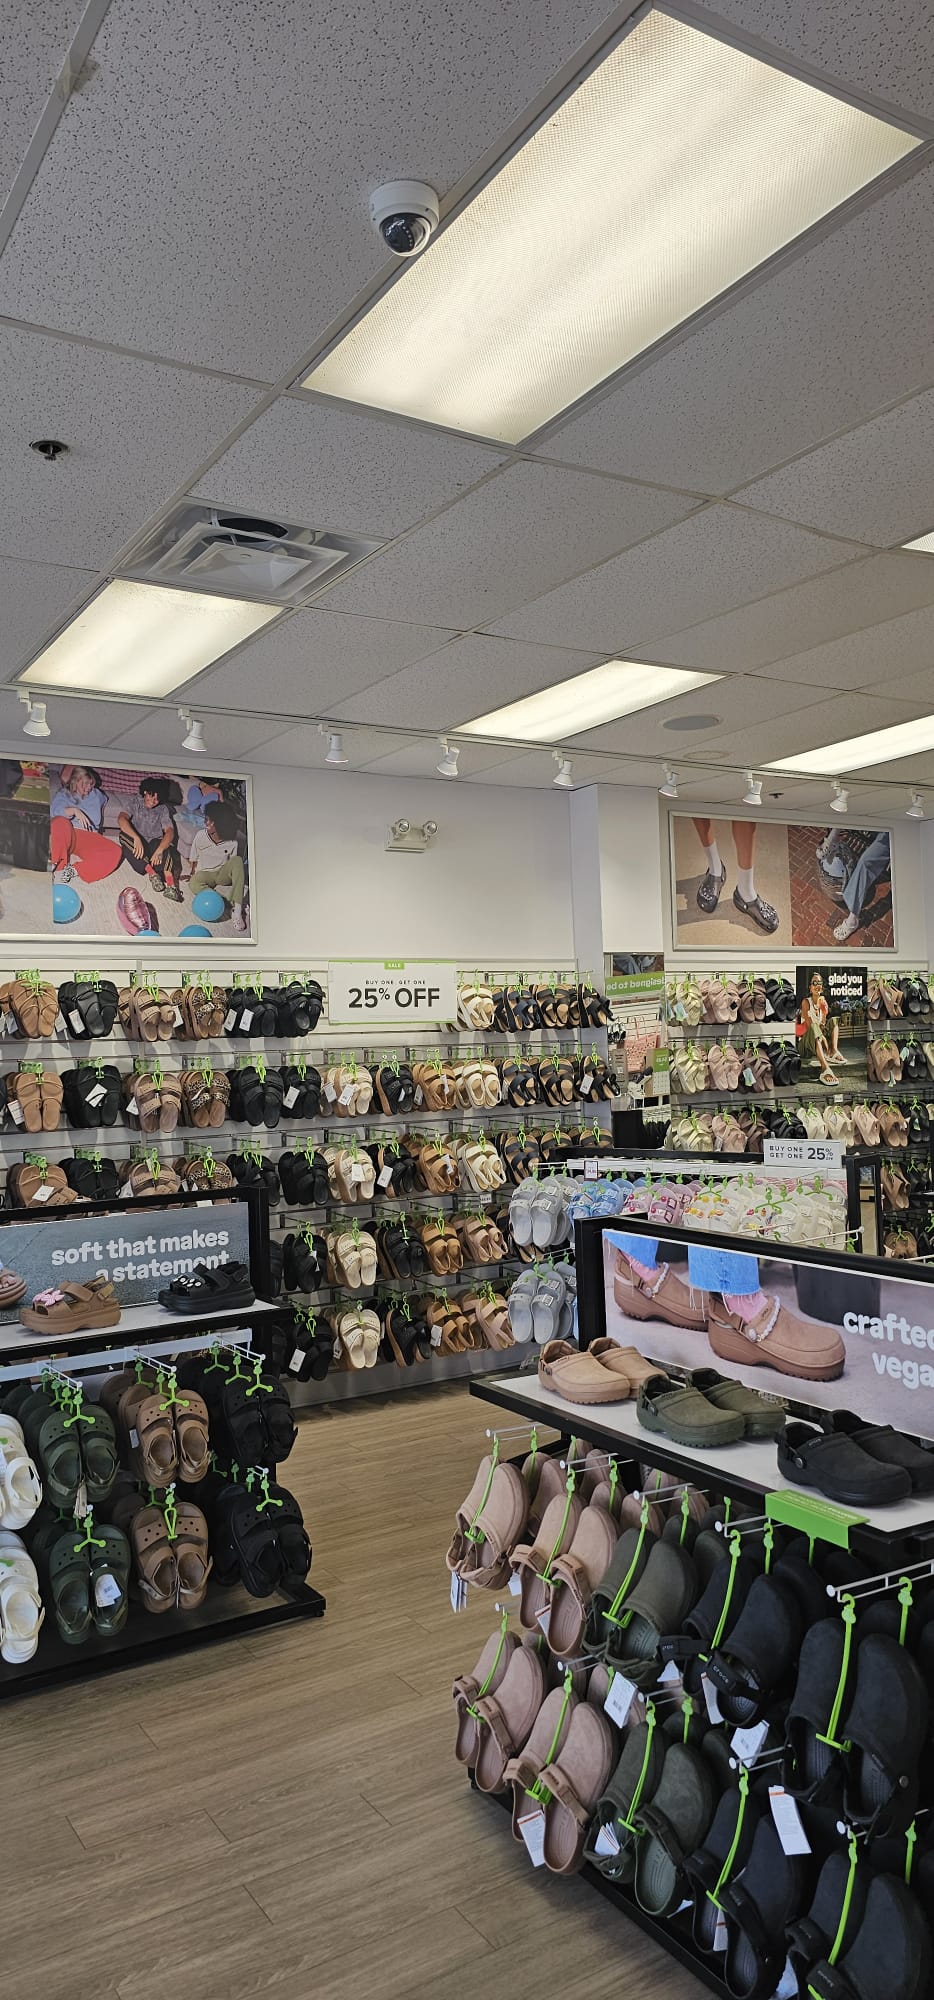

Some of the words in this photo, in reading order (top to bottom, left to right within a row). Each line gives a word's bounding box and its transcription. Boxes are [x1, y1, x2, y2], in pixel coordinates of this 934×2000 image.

[828, 972, 847, 986] glad
[847, 975, 862, 986] you
[348, 987, 391, 1009] 25%
[394, 987, 440, 1008] OFF
[831, 985, 863, 996] noticed
[51, 1241, 103, 1266] soft
[106, 1235, 157, 1259] that
[160, 1229, 230, 1253] makes
